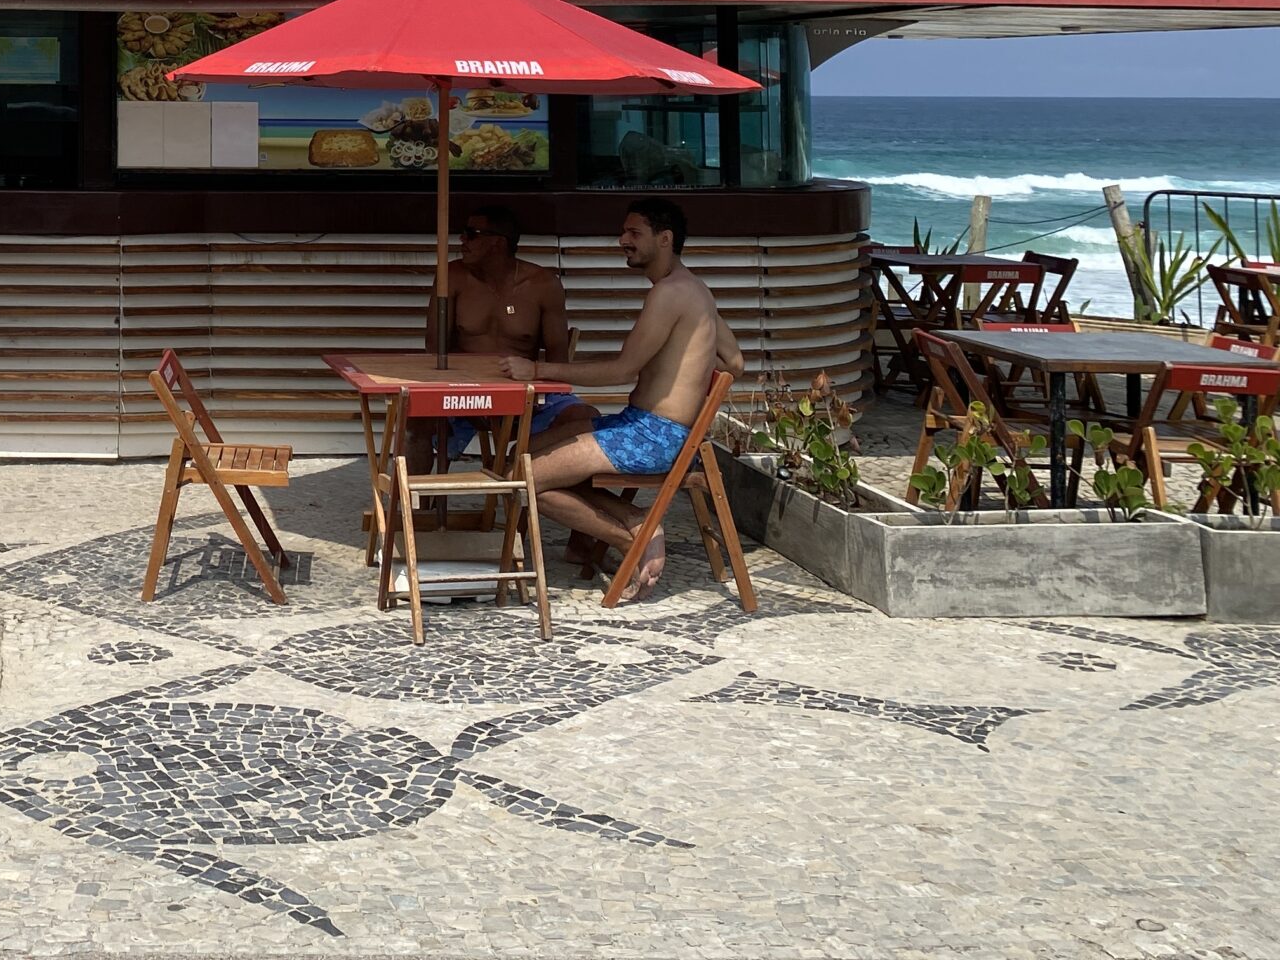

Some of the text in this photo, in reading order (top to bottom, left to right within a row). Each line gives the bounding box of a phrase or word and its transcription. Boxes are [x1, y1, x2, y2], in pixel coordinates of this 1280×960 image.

[243, 60, 317, 73] BRAHMA
[455, 60, 544, 75] BRAHMA
[1200, 374, 1248, 387] BRAHMA
[443, 395, 493, 410] BRAHMA
